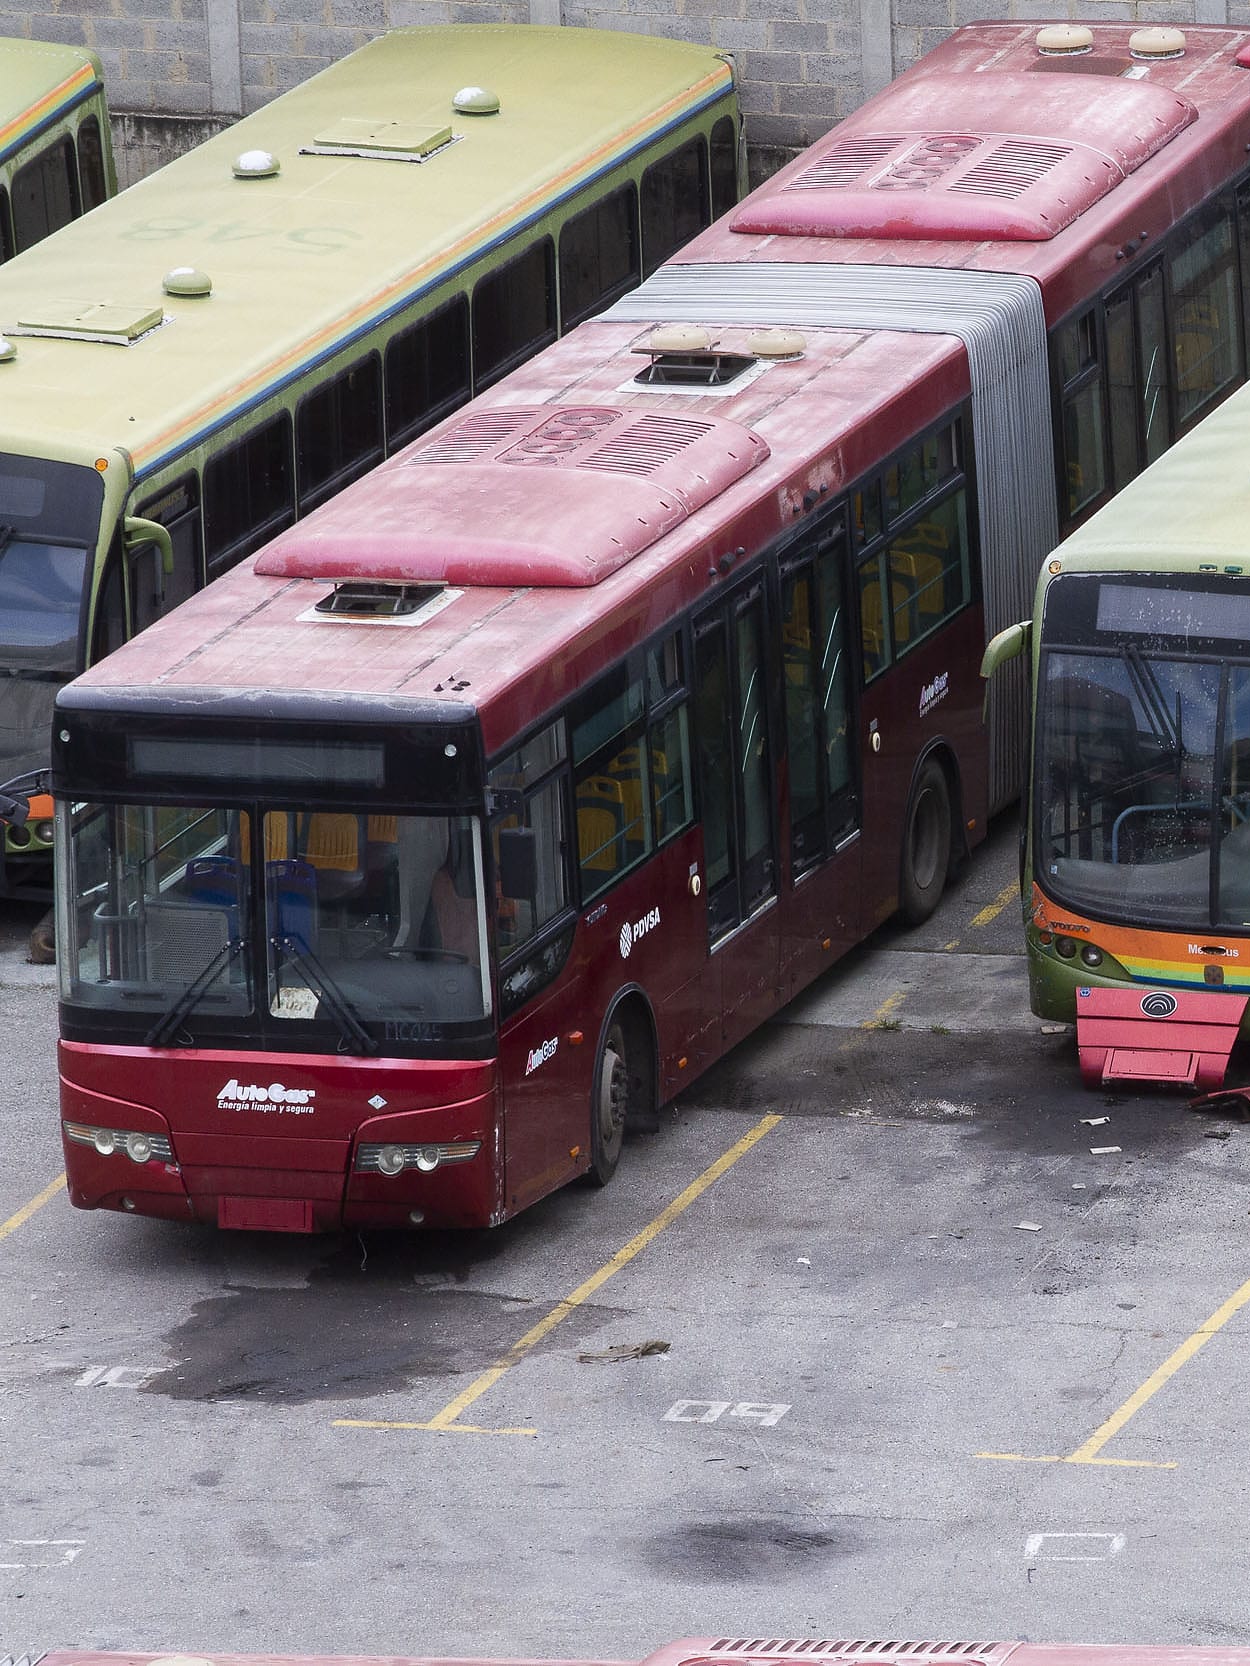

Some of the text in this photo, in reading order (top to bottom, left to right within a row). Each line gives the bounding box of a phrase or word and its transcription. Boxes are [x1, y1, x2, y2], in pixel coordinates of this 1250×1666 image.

[633, 906, 660, 942] PDVSA
[1188, 944, 1240, 958] Meus
[525, 1036, 558, 1076] AutoGas
[216, 1079, 315, 1104] AutoGas
[279, 1104, 285, 1114] y
[286, 1104, 315, 1115] segura
